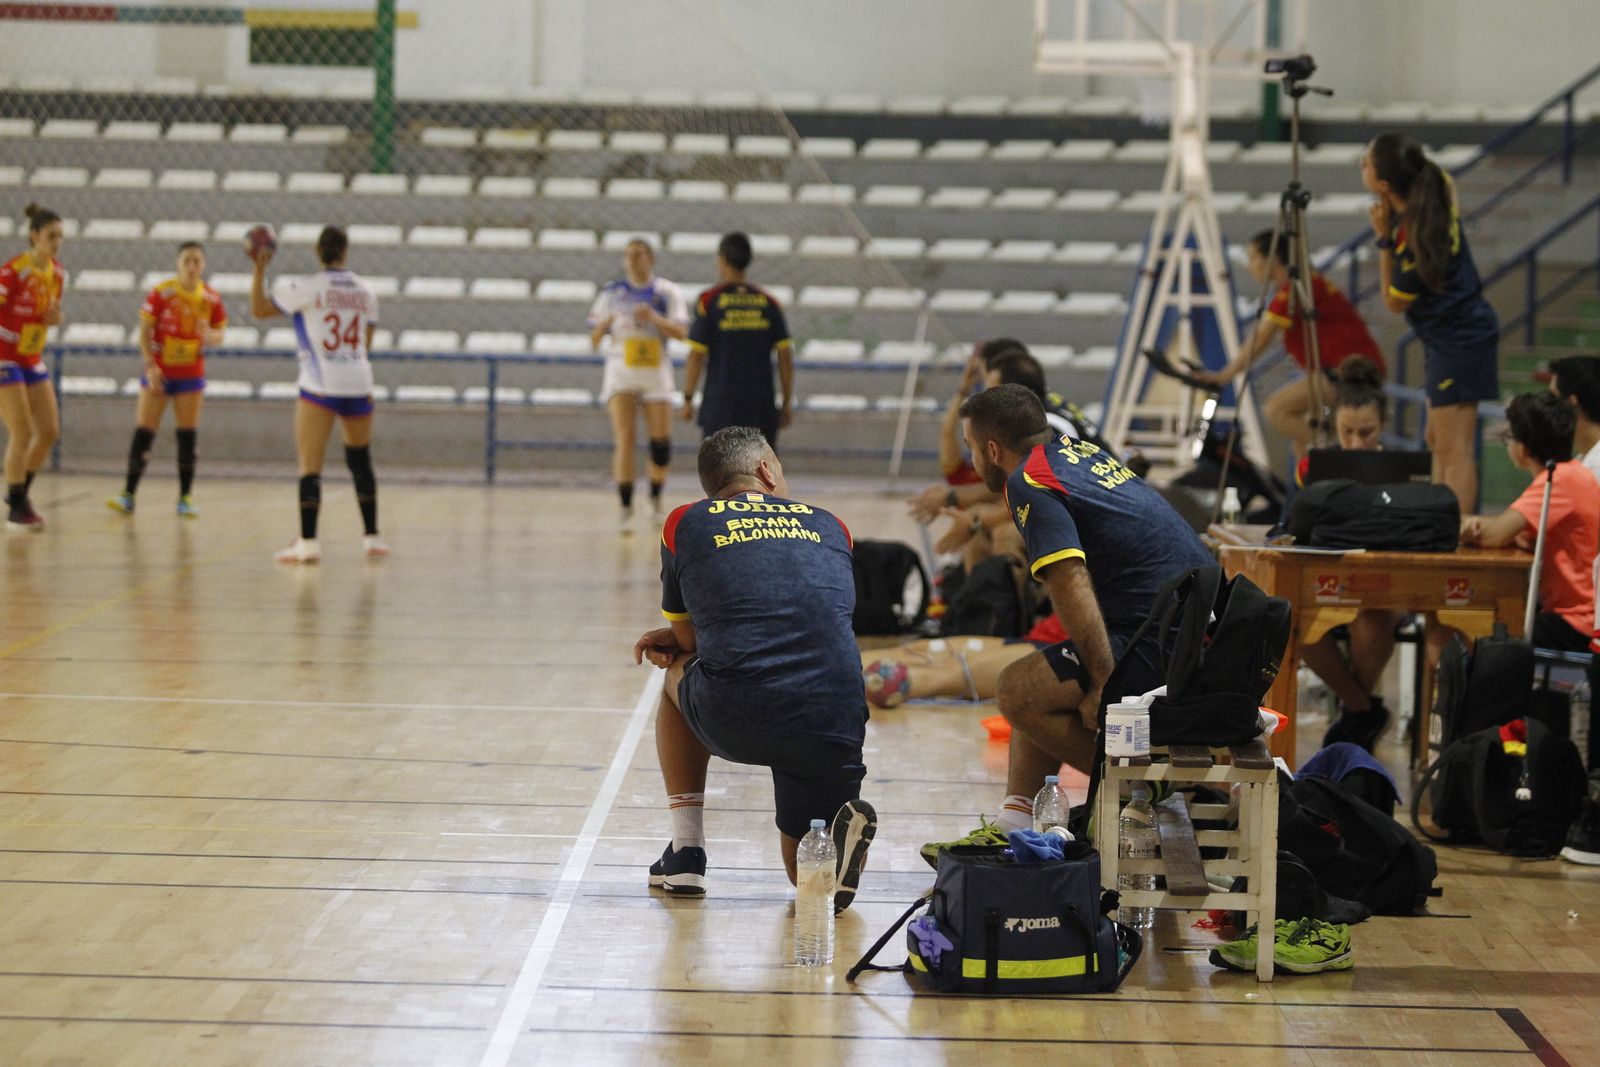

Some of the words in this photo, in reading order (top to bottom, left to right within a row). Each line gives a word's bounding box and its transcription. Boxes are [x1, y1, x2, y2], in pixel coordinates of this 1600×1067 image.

[322, 312, 360, 351] 34
[708, 500, 813, 514] Joma
[726, 516, 802, 531] ESPAÑA
[713, 528, 821, 548] BALONMANO
[1018, 916, 1061, 932] Joma
